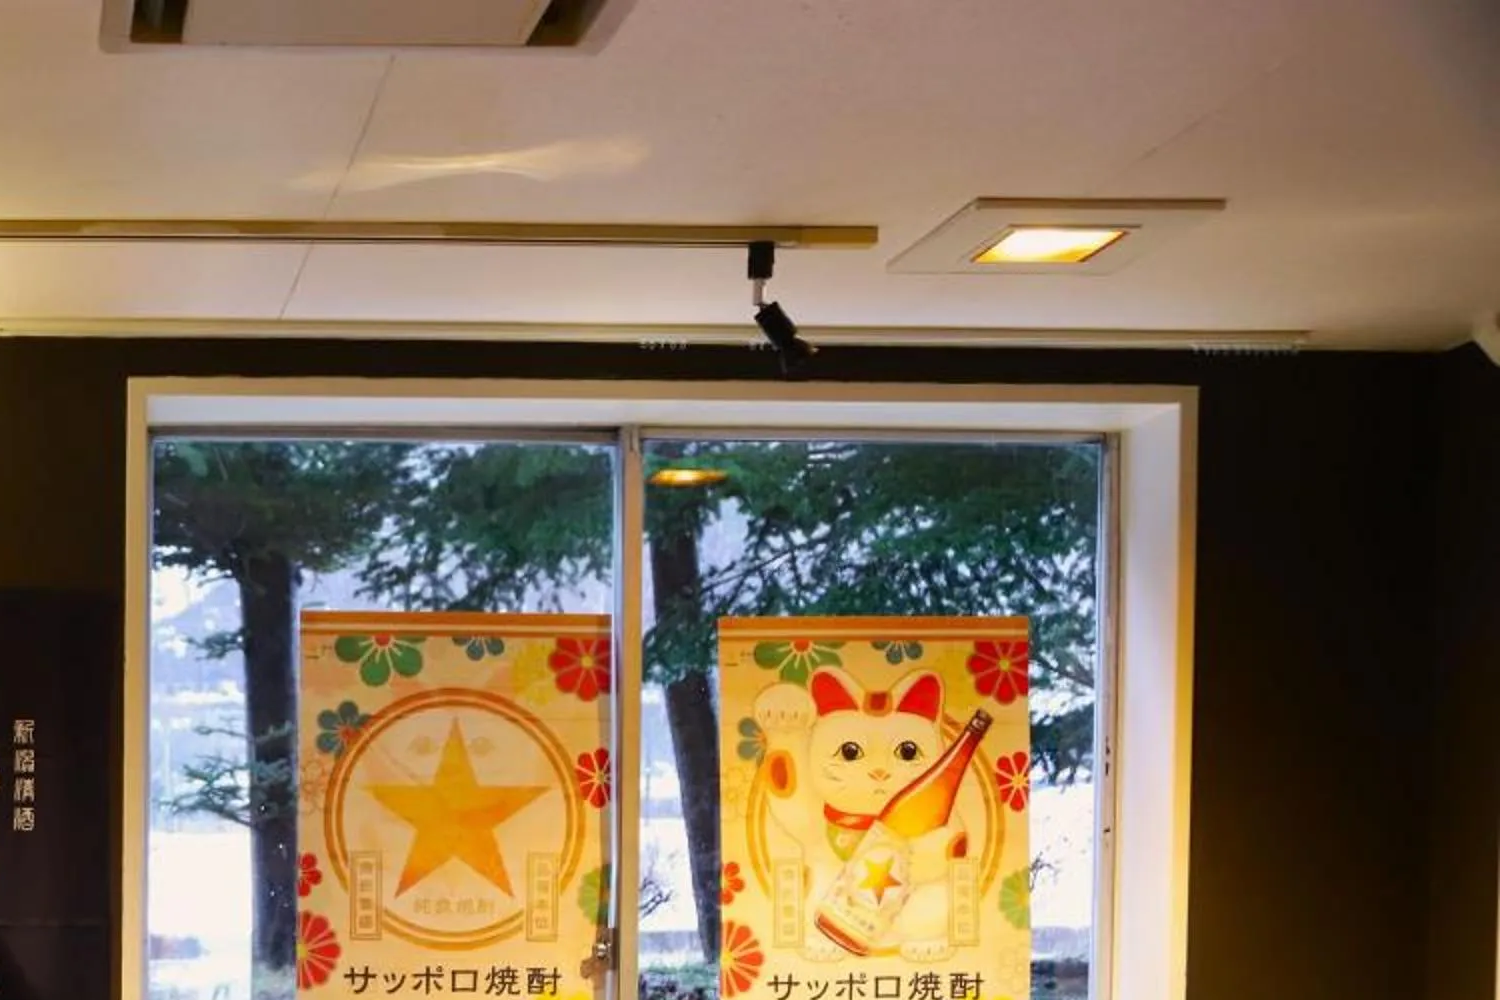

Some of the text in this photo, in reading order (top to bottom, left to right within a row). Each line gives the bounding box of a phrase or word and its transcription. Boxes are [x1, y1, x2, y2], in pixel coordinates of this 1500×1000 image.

[343, 965, 562, 997] サッポロ焼酎
